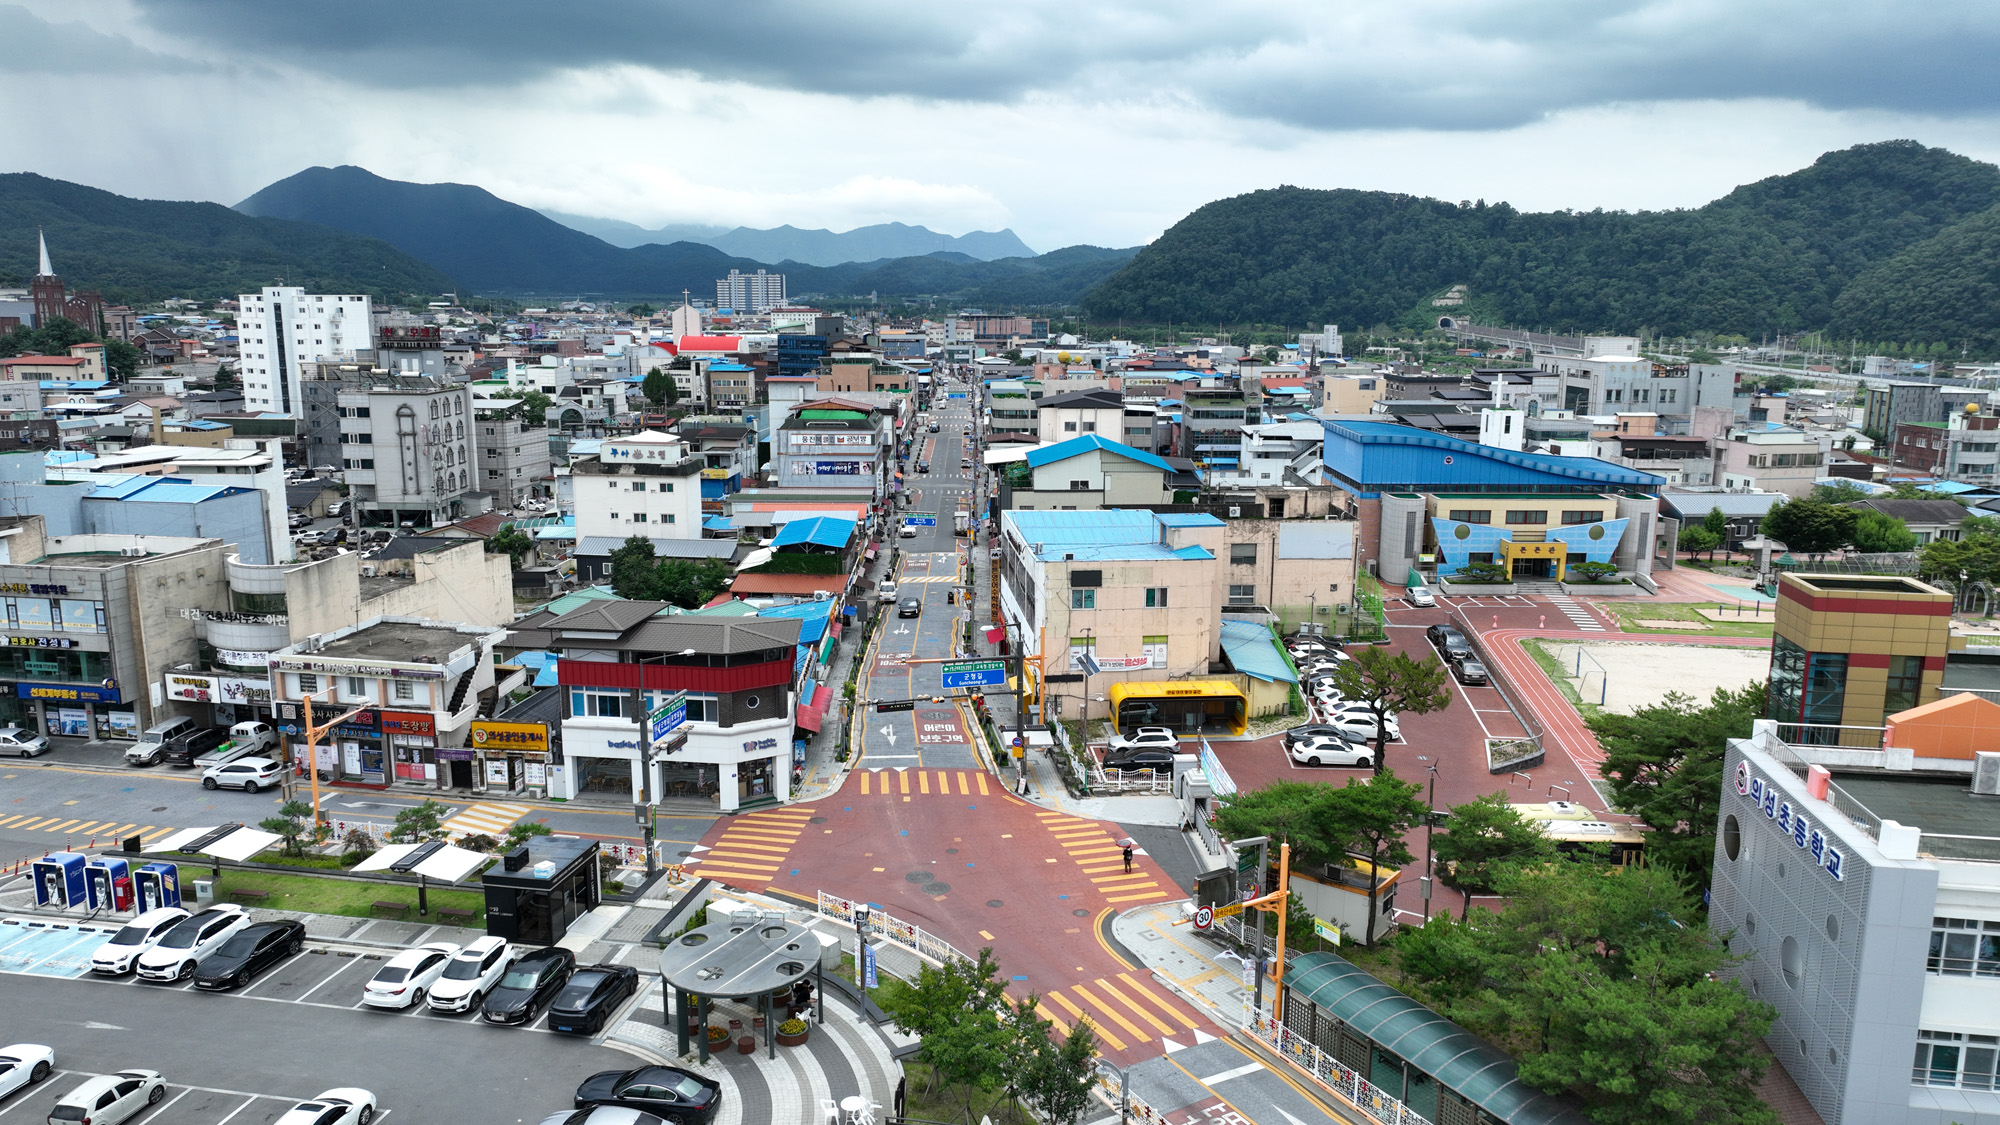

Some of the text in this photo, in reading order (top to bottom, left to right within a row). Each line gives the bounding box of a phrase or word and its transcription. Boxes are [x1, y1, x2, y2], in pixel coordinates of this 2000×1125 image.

[647, 449, 666, 460] 모텔
[180, 608, 200, 620] 대건
[266, 614, 287, 627] 이건
[11, 637, 70, 649] 변호사 전성배
[1124, 657, 1148, 667] 윤선생
[311, 662, 323, 671] LG
[324, 663, 359, 674] WHISEN
[964, 672, 983, 680] 군청길
[183, 689, 208, 699] 이건
[402, 720, 431, 732] 도장방
[923, 724, 956, 732] 어린이
[476, 732, 486, 742] 땅
[487, 731, 544, 743] 의성공인중개사
[920, 734, 964, 743] 보호구역
[1750, 777, 1844, 881] 의성초등학교
[1199, 911, 1209, 923] 30
